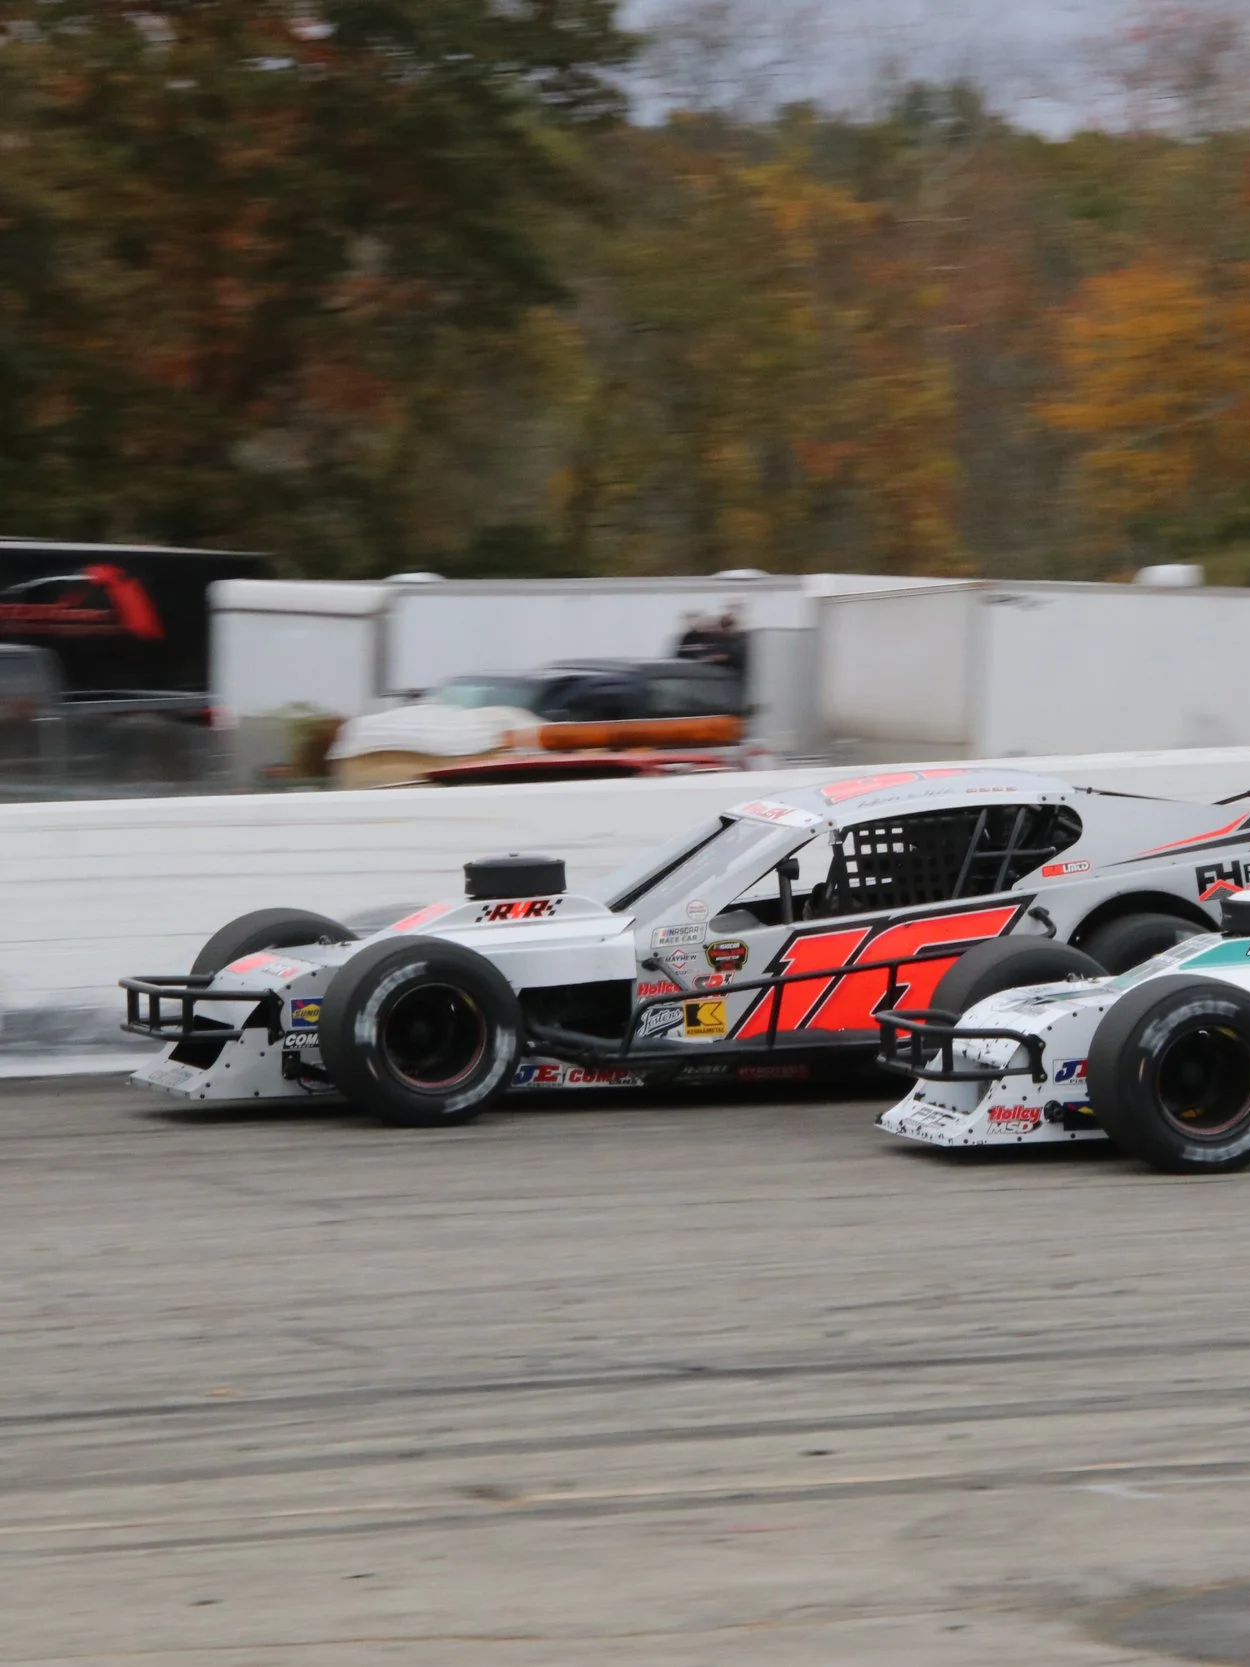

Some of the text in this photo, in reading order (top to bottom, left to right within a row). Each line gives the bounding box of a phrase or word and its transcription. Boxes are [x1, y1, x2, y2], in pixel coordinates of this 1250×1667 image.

[659, 934, 698, 945] RACE CAR
[665, 954, 697, 963] MAYHEW
[636, 979, 683, 997] Holle
[295, 1007, 320, 1018] SUNO
[989, 1105, 1041, 1123] Holley
[987, 1121, 1040, 1135] MSD
